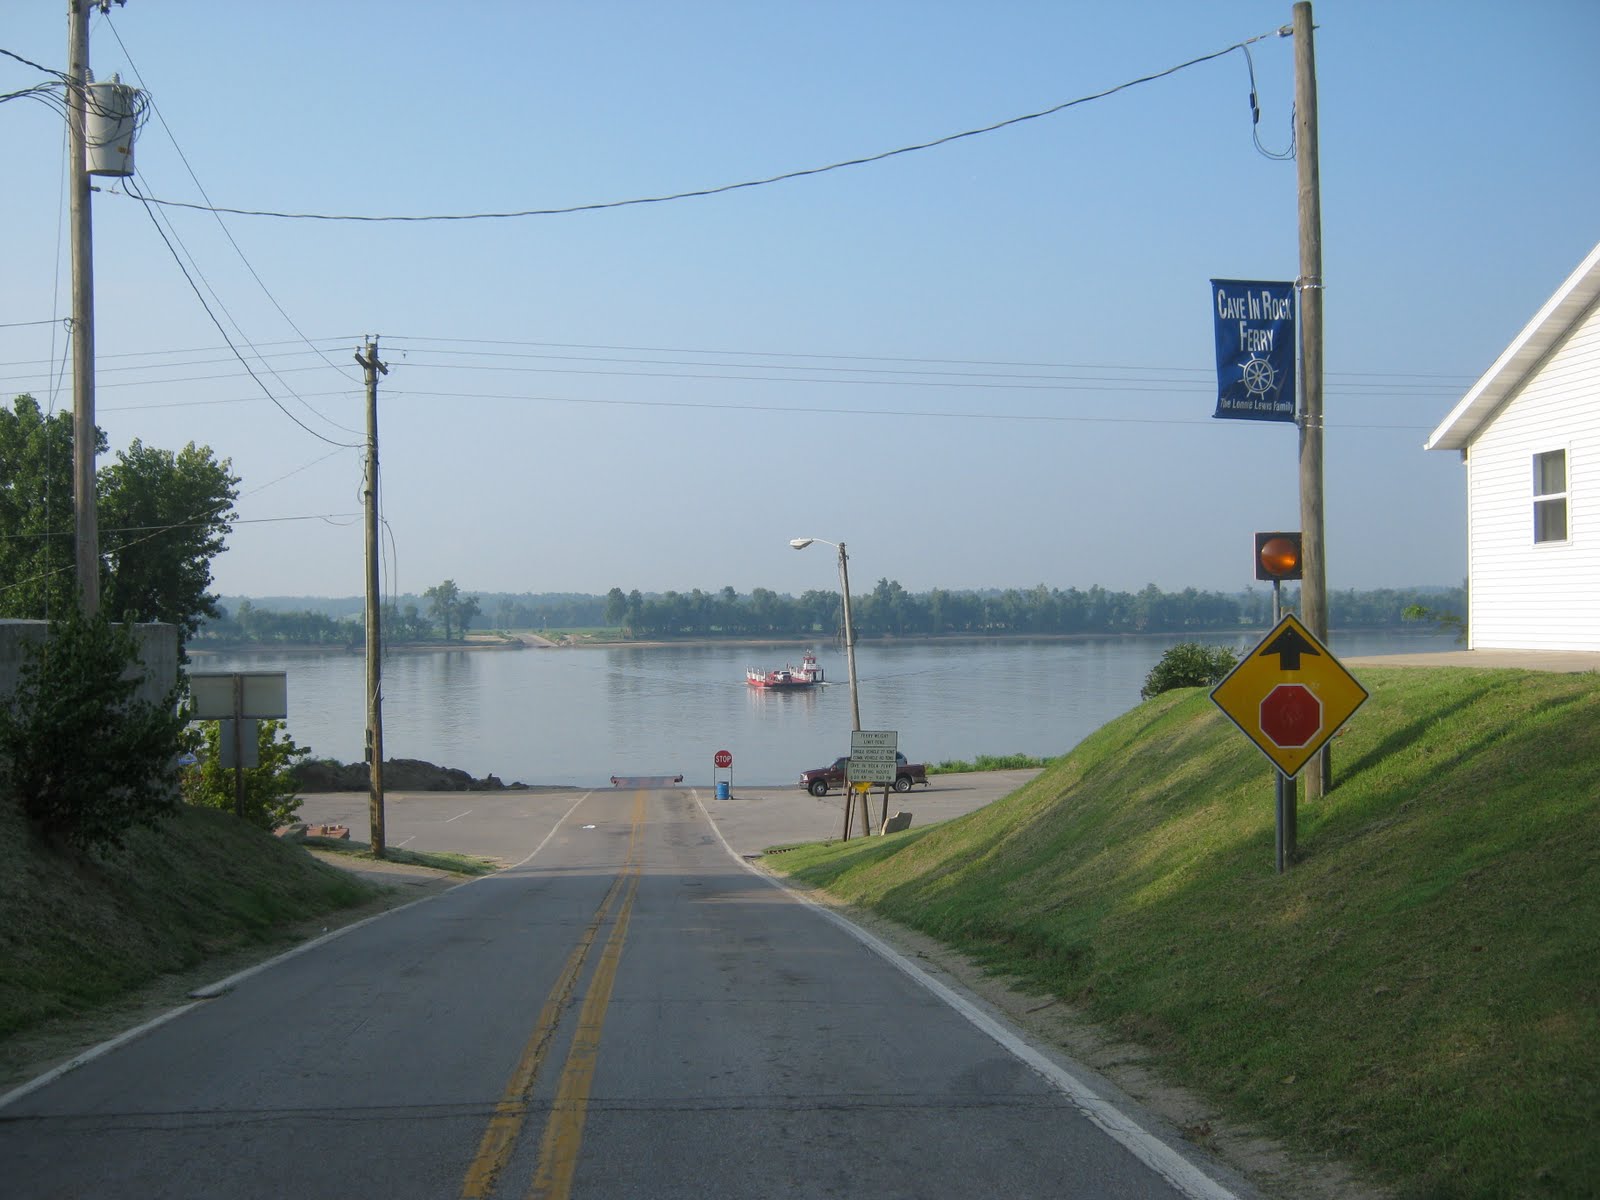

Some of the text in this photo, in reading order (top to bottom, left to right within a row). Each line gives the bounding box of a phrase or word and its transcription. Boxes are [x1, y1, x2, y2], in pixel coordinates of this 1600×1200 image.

[1218, 289, 1292, 320] CAVE IN ROCK
[1240, 320, 1274, 351] FERRY
[1220, 398, 1231, 409] The
[1273, 401, 1293, 414] Family
[715, 755, 732, 763] STOP
